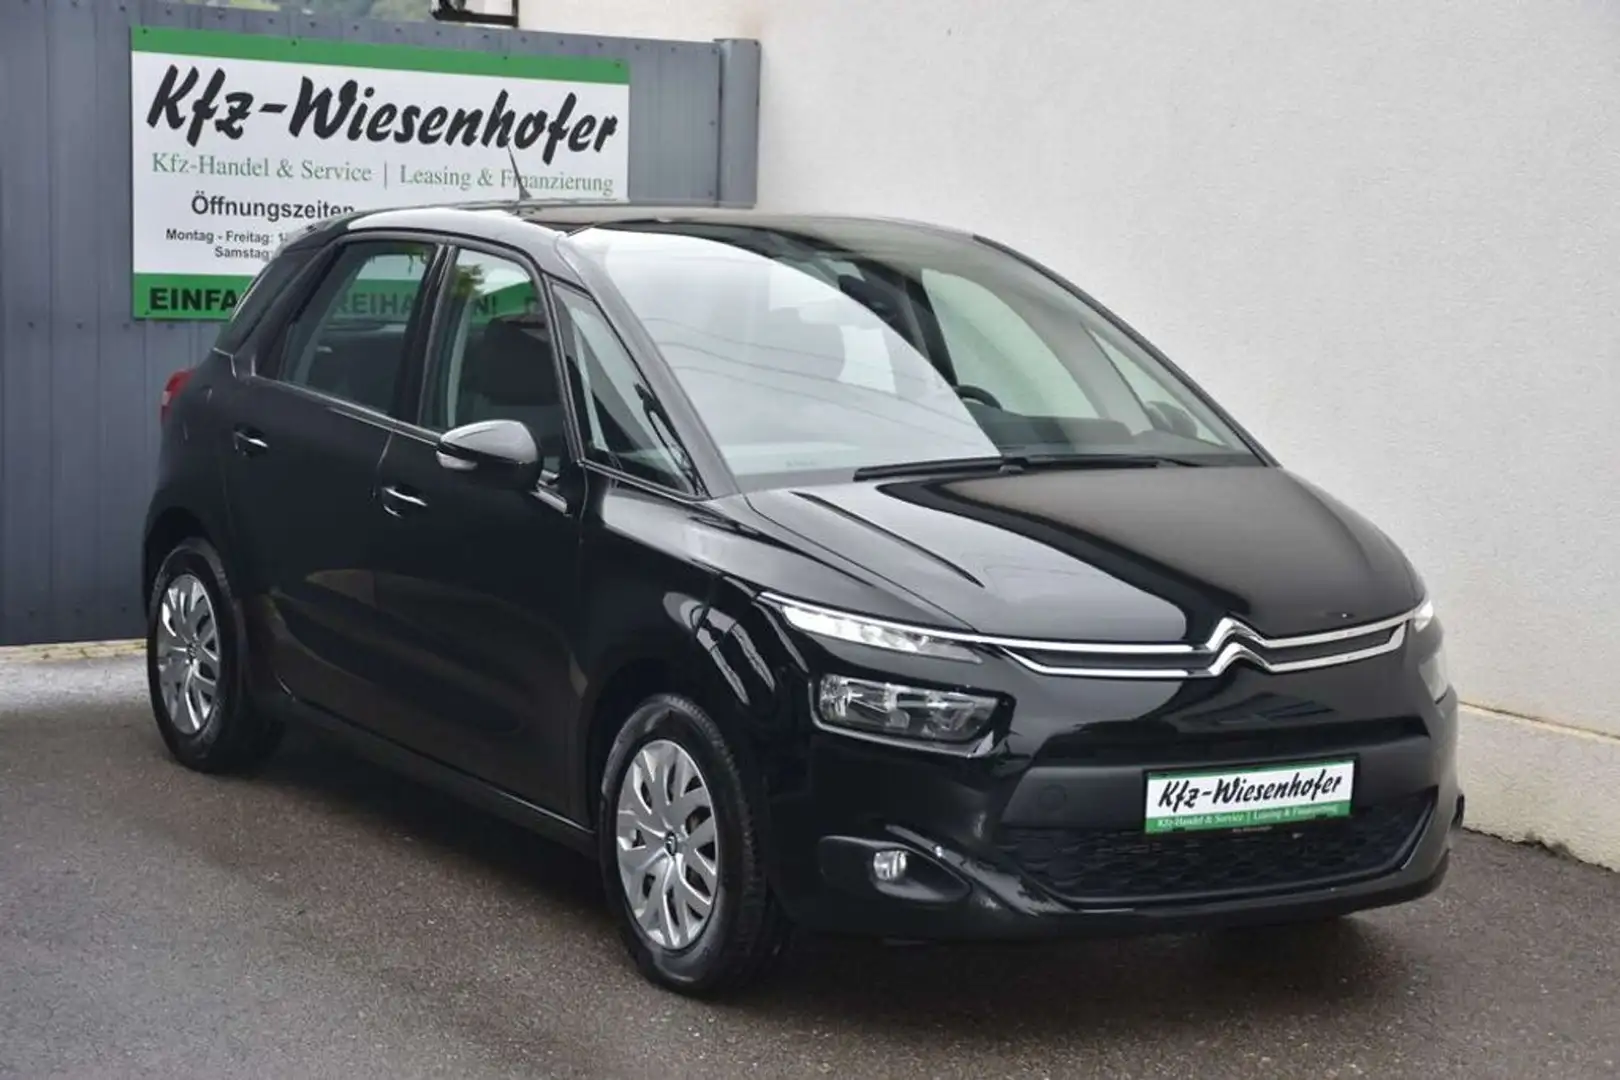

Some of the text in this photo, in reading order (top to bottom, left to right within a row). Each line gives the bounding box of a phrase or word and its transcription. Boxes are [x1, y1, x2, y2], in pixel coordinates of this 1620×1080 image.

[146, 63, 618, 166] Kfz-Wiesenhofer
[152, 152, 270, 178] Kfz-Handel
[276, 159, 294, 179] &
[301, 160, 373, 182] Service
[400, 164, 472, 191] Leasing
[477, 168, 494, 187] &
[500, 168, 614, 197] Finanzierung
[165, 228, 214, 244] Montag
[150, 286, 238, 312] EINFA
[1158, 768, 1343, 813] Kfz-Wiesenhofer
